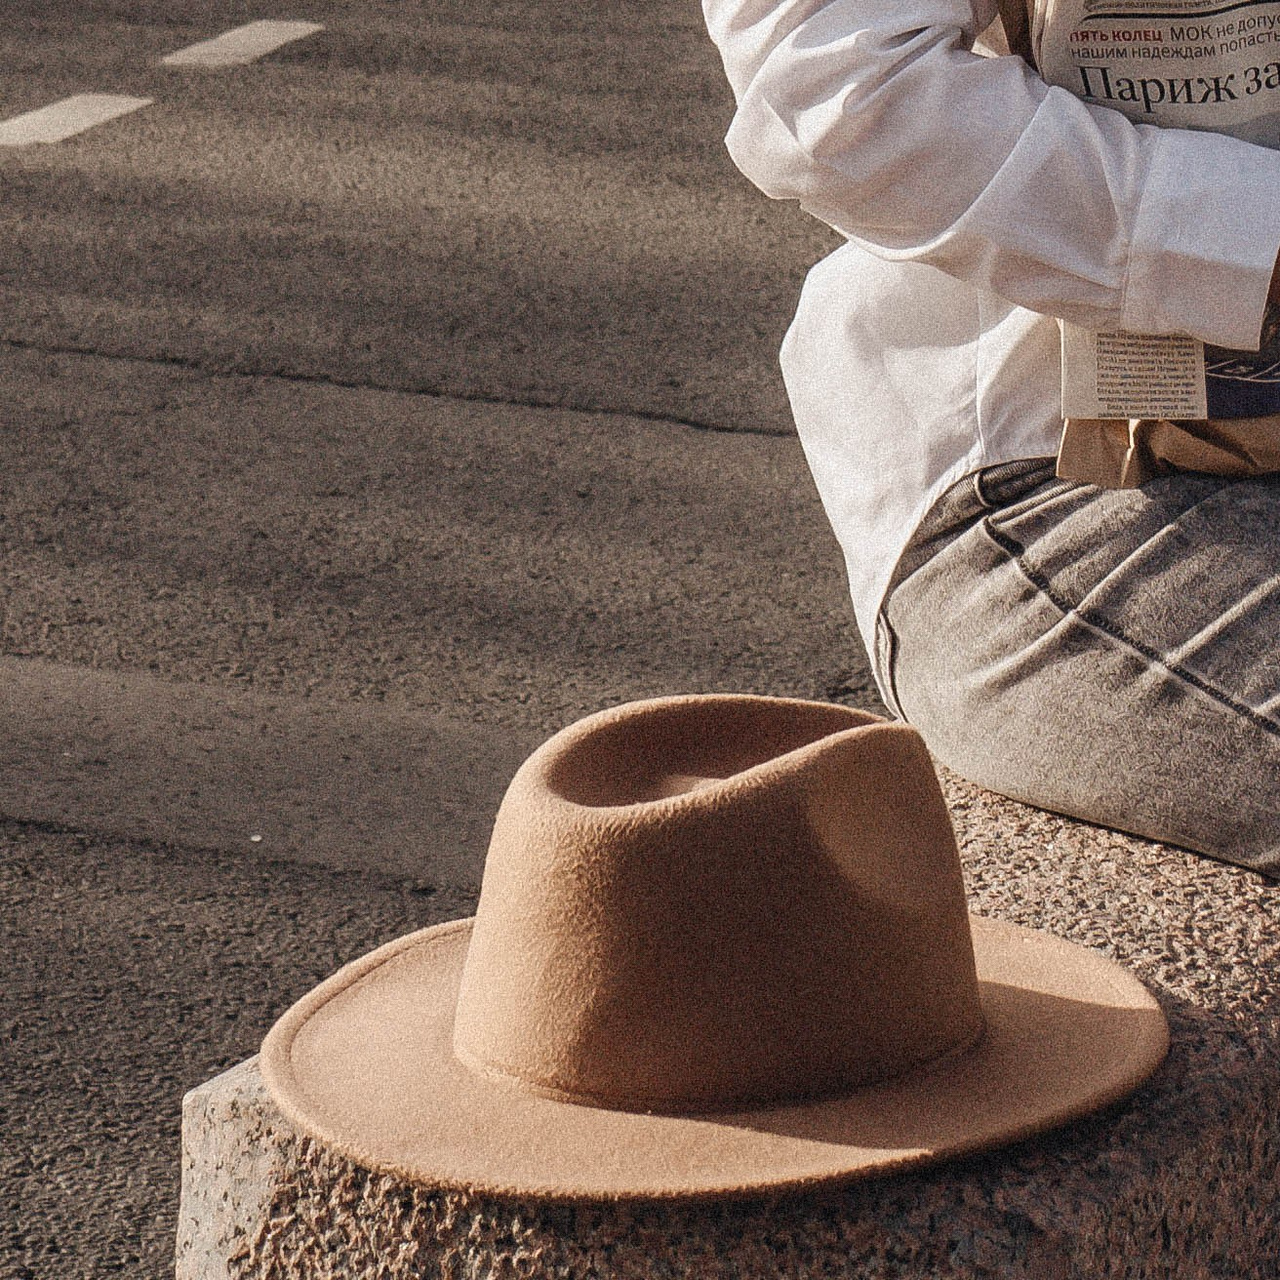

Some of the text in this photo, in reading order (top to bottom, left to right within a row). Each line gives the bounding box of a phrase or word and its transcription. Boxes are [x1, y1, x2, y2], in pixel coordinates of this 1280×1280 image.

[1112, 30, 1163, 43] КОЛЕЦ
[1170, 25, 1212, 41] МОК
[1217, 23, 1235, 37] не
[1071, 46, 1128, 59] нашим
[1132, 44, 1216, 60] надеждам
[1076, 65, 1239, 114] Париж
